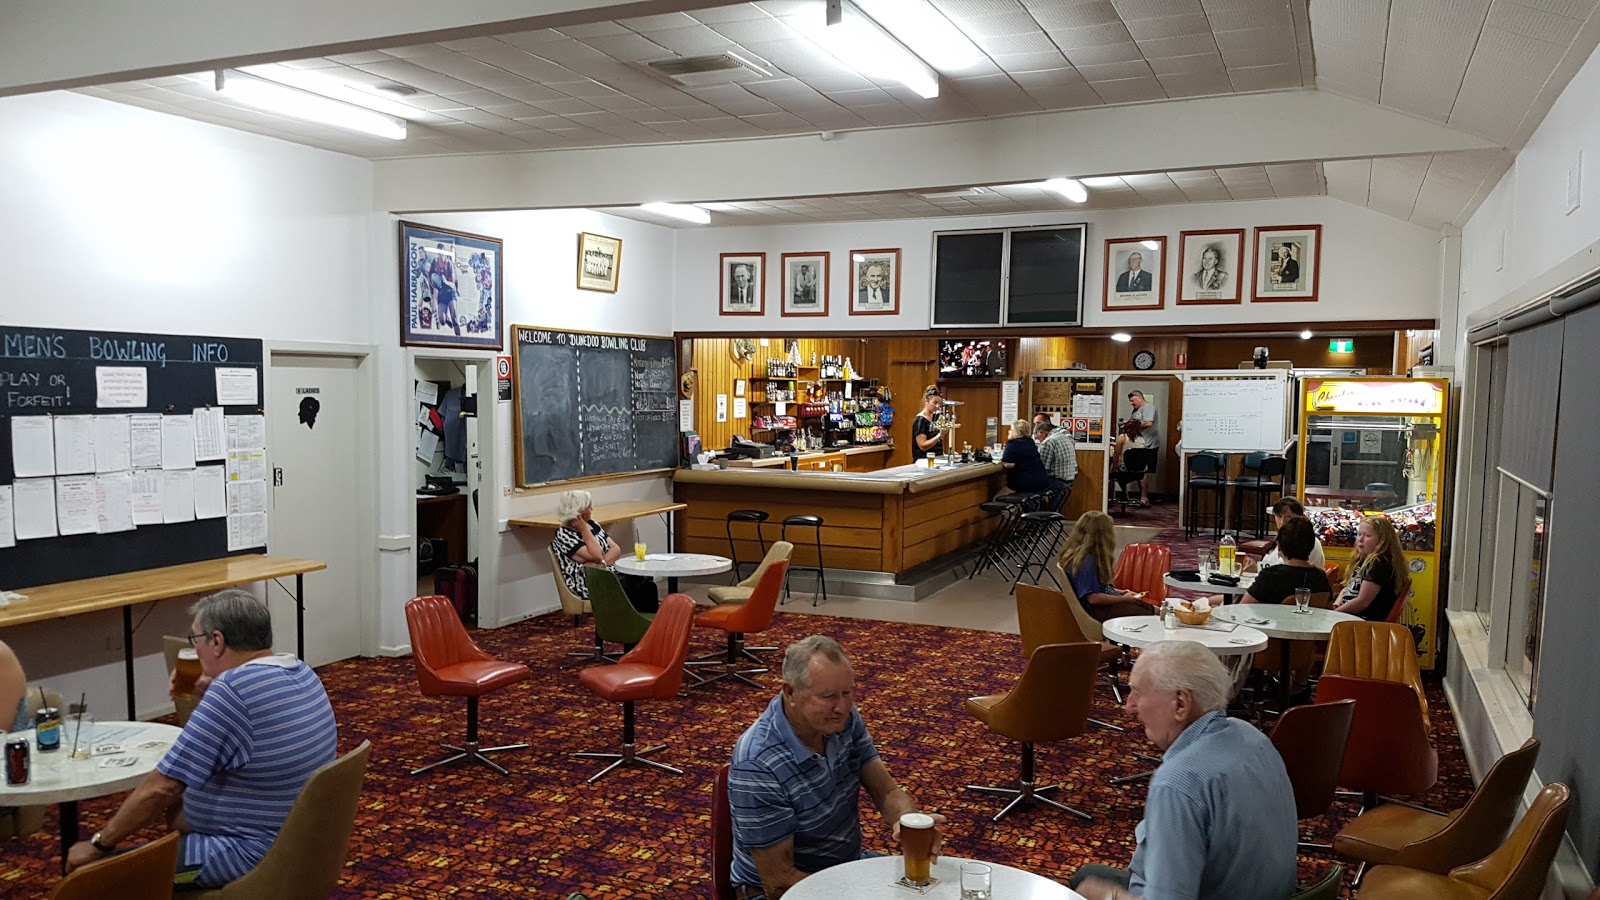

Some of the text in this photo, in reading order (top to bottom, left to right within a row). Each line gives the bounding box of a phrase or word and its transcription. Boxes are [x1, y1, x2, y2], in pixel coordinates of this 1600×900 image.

[410, 242, 418, 303] HARRAGON
[4, 333, 228, 367] MEN'S BOWLING INFO
[518, 329, 552, 344] WELCOME
[568, 333, 600, 348] DUNEDOO
[600, 335, 629, 351] BOWLING
[630, 337, 647, 352] CLUB
[0, 371, 66, 387] PLAY OR
[8, 386, 71, 408] FORFEIT!
